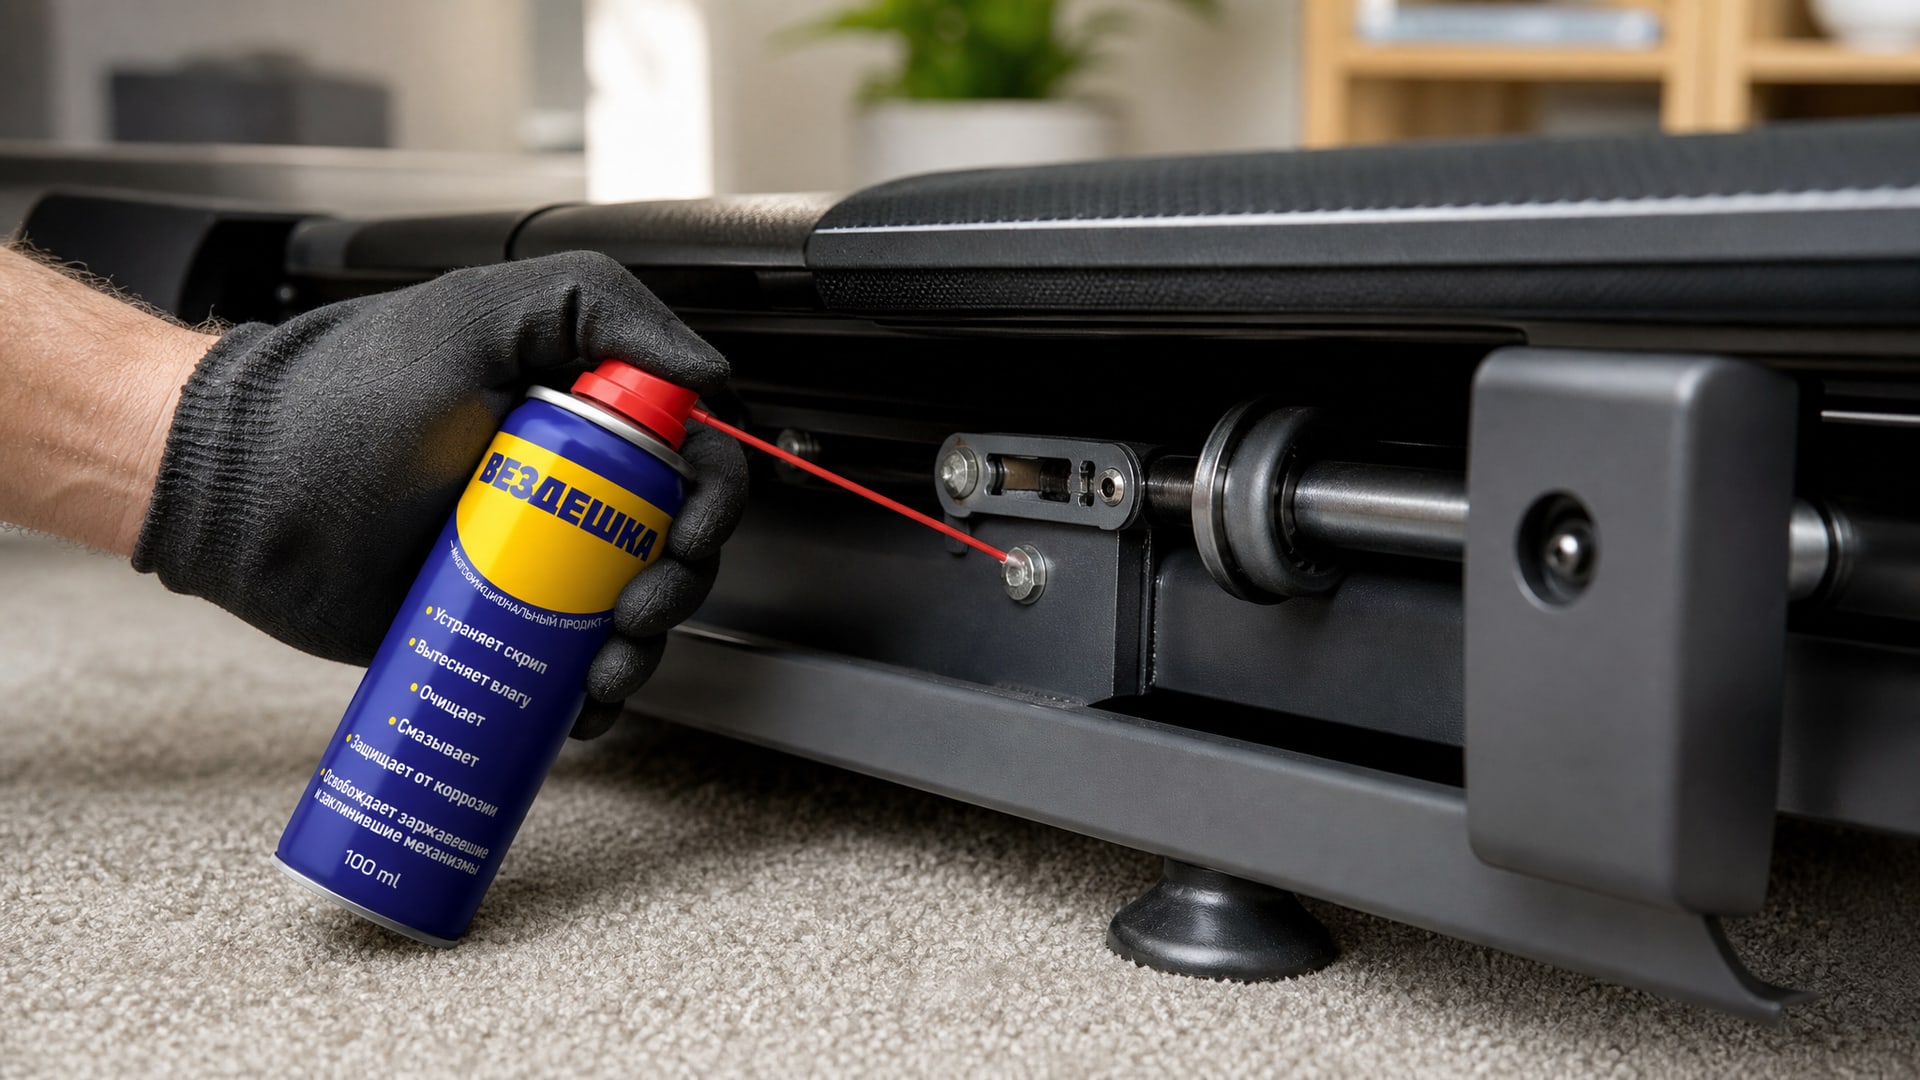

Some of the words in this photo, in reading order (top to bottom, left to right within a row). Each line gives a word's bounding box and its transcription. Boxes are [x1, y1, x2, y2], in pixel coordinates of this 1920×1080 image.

[478, 451, 658, 562] ВЕЗДЕШКА
[414, 639, 490, 686] Вытесняет
[489, 680, 532, 709] влагу
[433, 607, 504, 652] Устраняет
[503, 646, 548, 675] скрип
[419, 684, 486, 727] Очищает
[350, 734, 414, 778] Защищает
[414, 771, 433, 788] от
[433, 781, 499, 818] коррозии
[397, 718, 479, 768] Смазывает
[322, 768, 398, 819] Освобождает
[313, 787, 321, 799] и
[319, 790, 403, 843] заклинившие
[403, 836, 481, 876] механизмы
[344, 849, 376, 876] 100
[377, 866, 402, 889] ml
